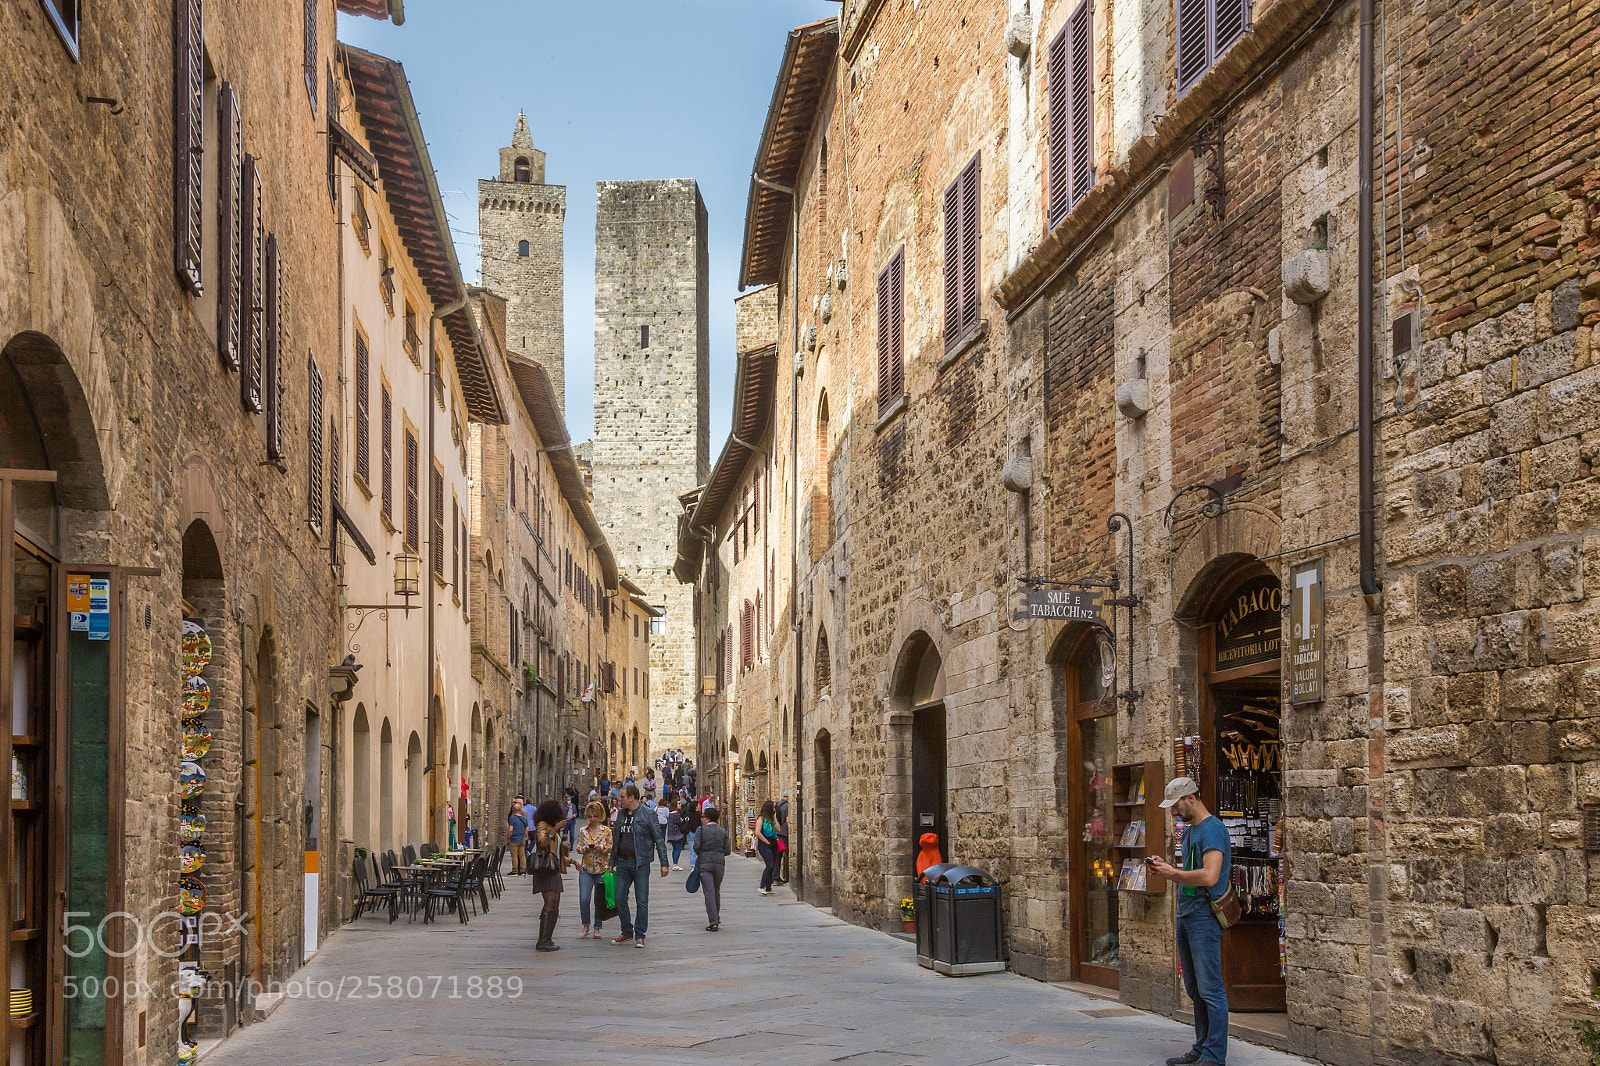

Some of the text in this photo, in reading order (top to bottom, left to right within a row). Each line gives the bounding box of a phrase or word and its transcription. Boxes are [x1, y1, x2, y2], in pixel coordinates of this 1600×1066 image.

[1047, 591, 1081, 605] SALE E
[1296, 569, 1317, 640] T
[1030, 603, 1080, 618] TABACCHI
[1293, 650, 1320, 666] TABACCHI
[1294, 667, 1317, 682] VALORI
[1294, 680, 1318, 695] BOLLATI
